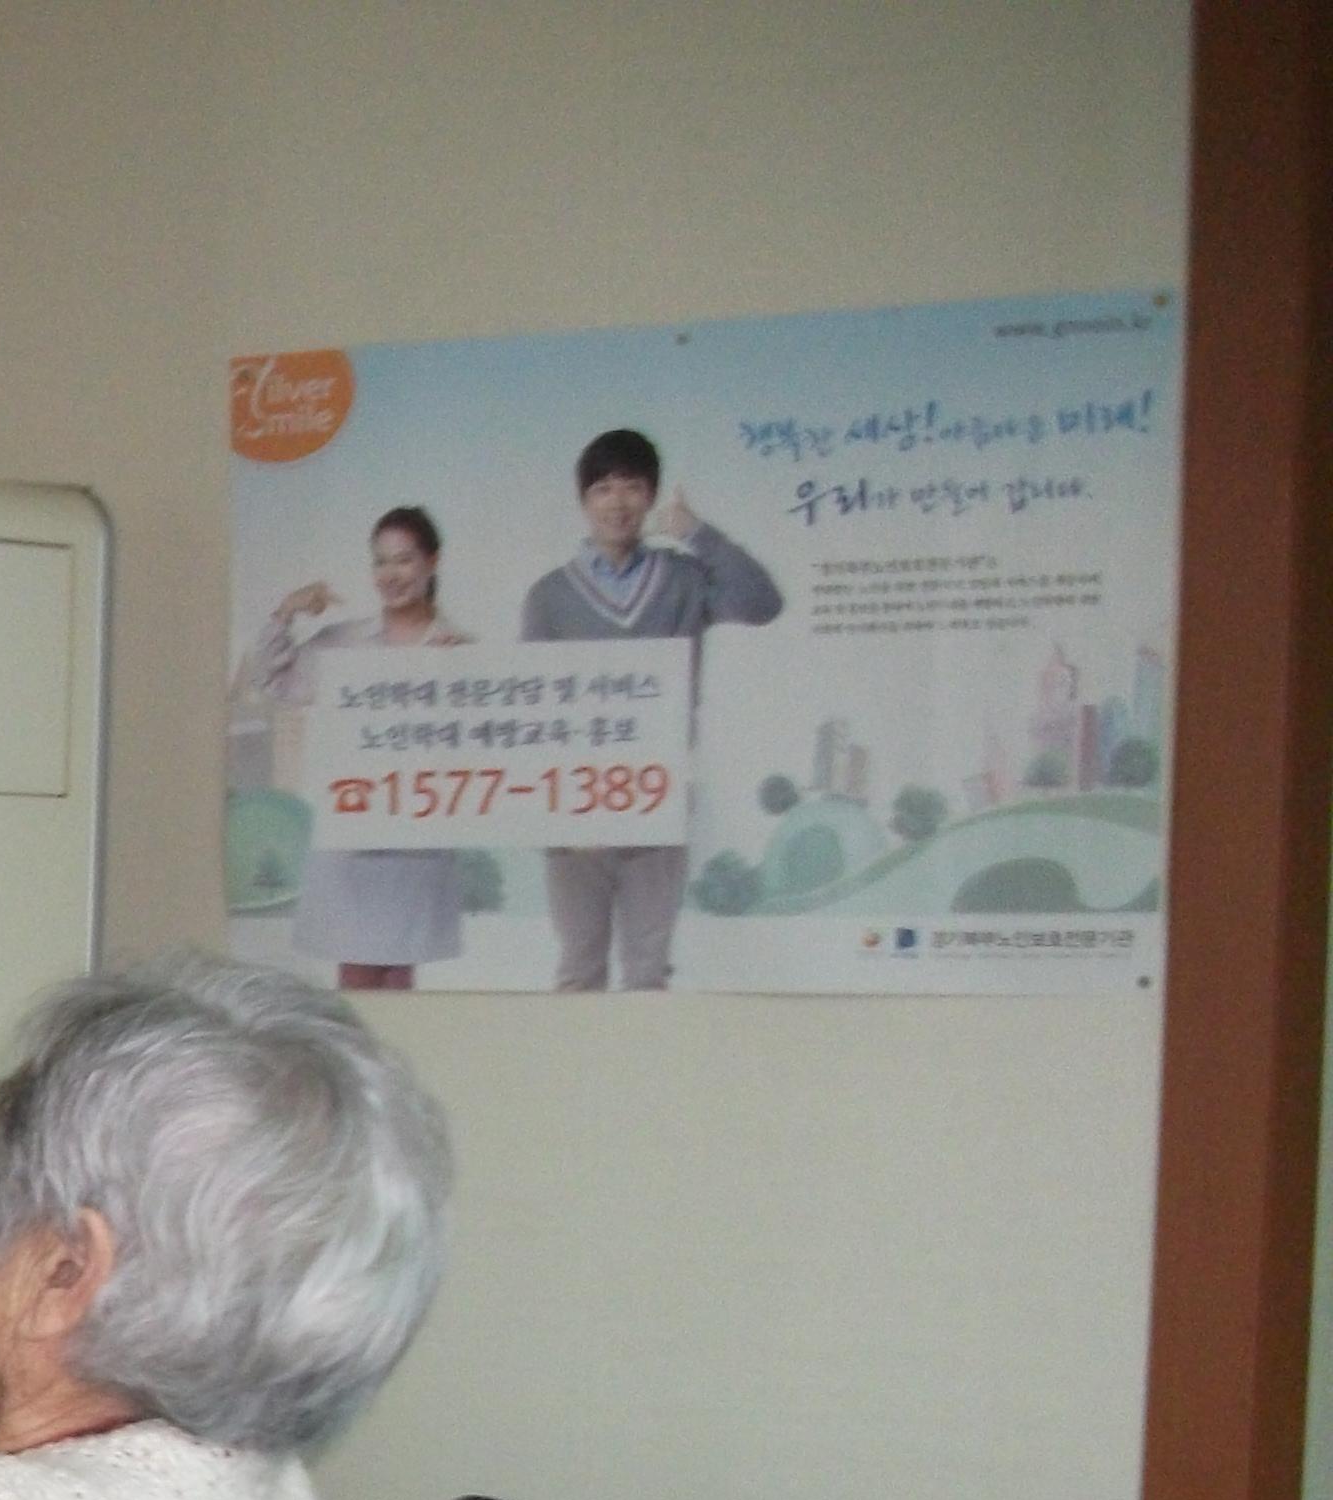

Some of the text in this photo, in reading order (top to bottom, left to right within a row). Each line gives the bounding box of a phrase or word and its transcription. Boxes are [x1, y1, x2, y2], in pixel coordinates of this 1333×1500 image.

[845, 400, 936, 452] 세상!
[1057, 389, 1153, 435] 미래!
[786, 477, 899, 526] 우리가
[338, 680, 438, 710] 노인학대
[446, 676, 546, 709] 전문상담
[586, 673, 662, 700] 서비스
[359, 719, 462, 751] 노인학대
[382, 763, 671, 820] 1577-1389
